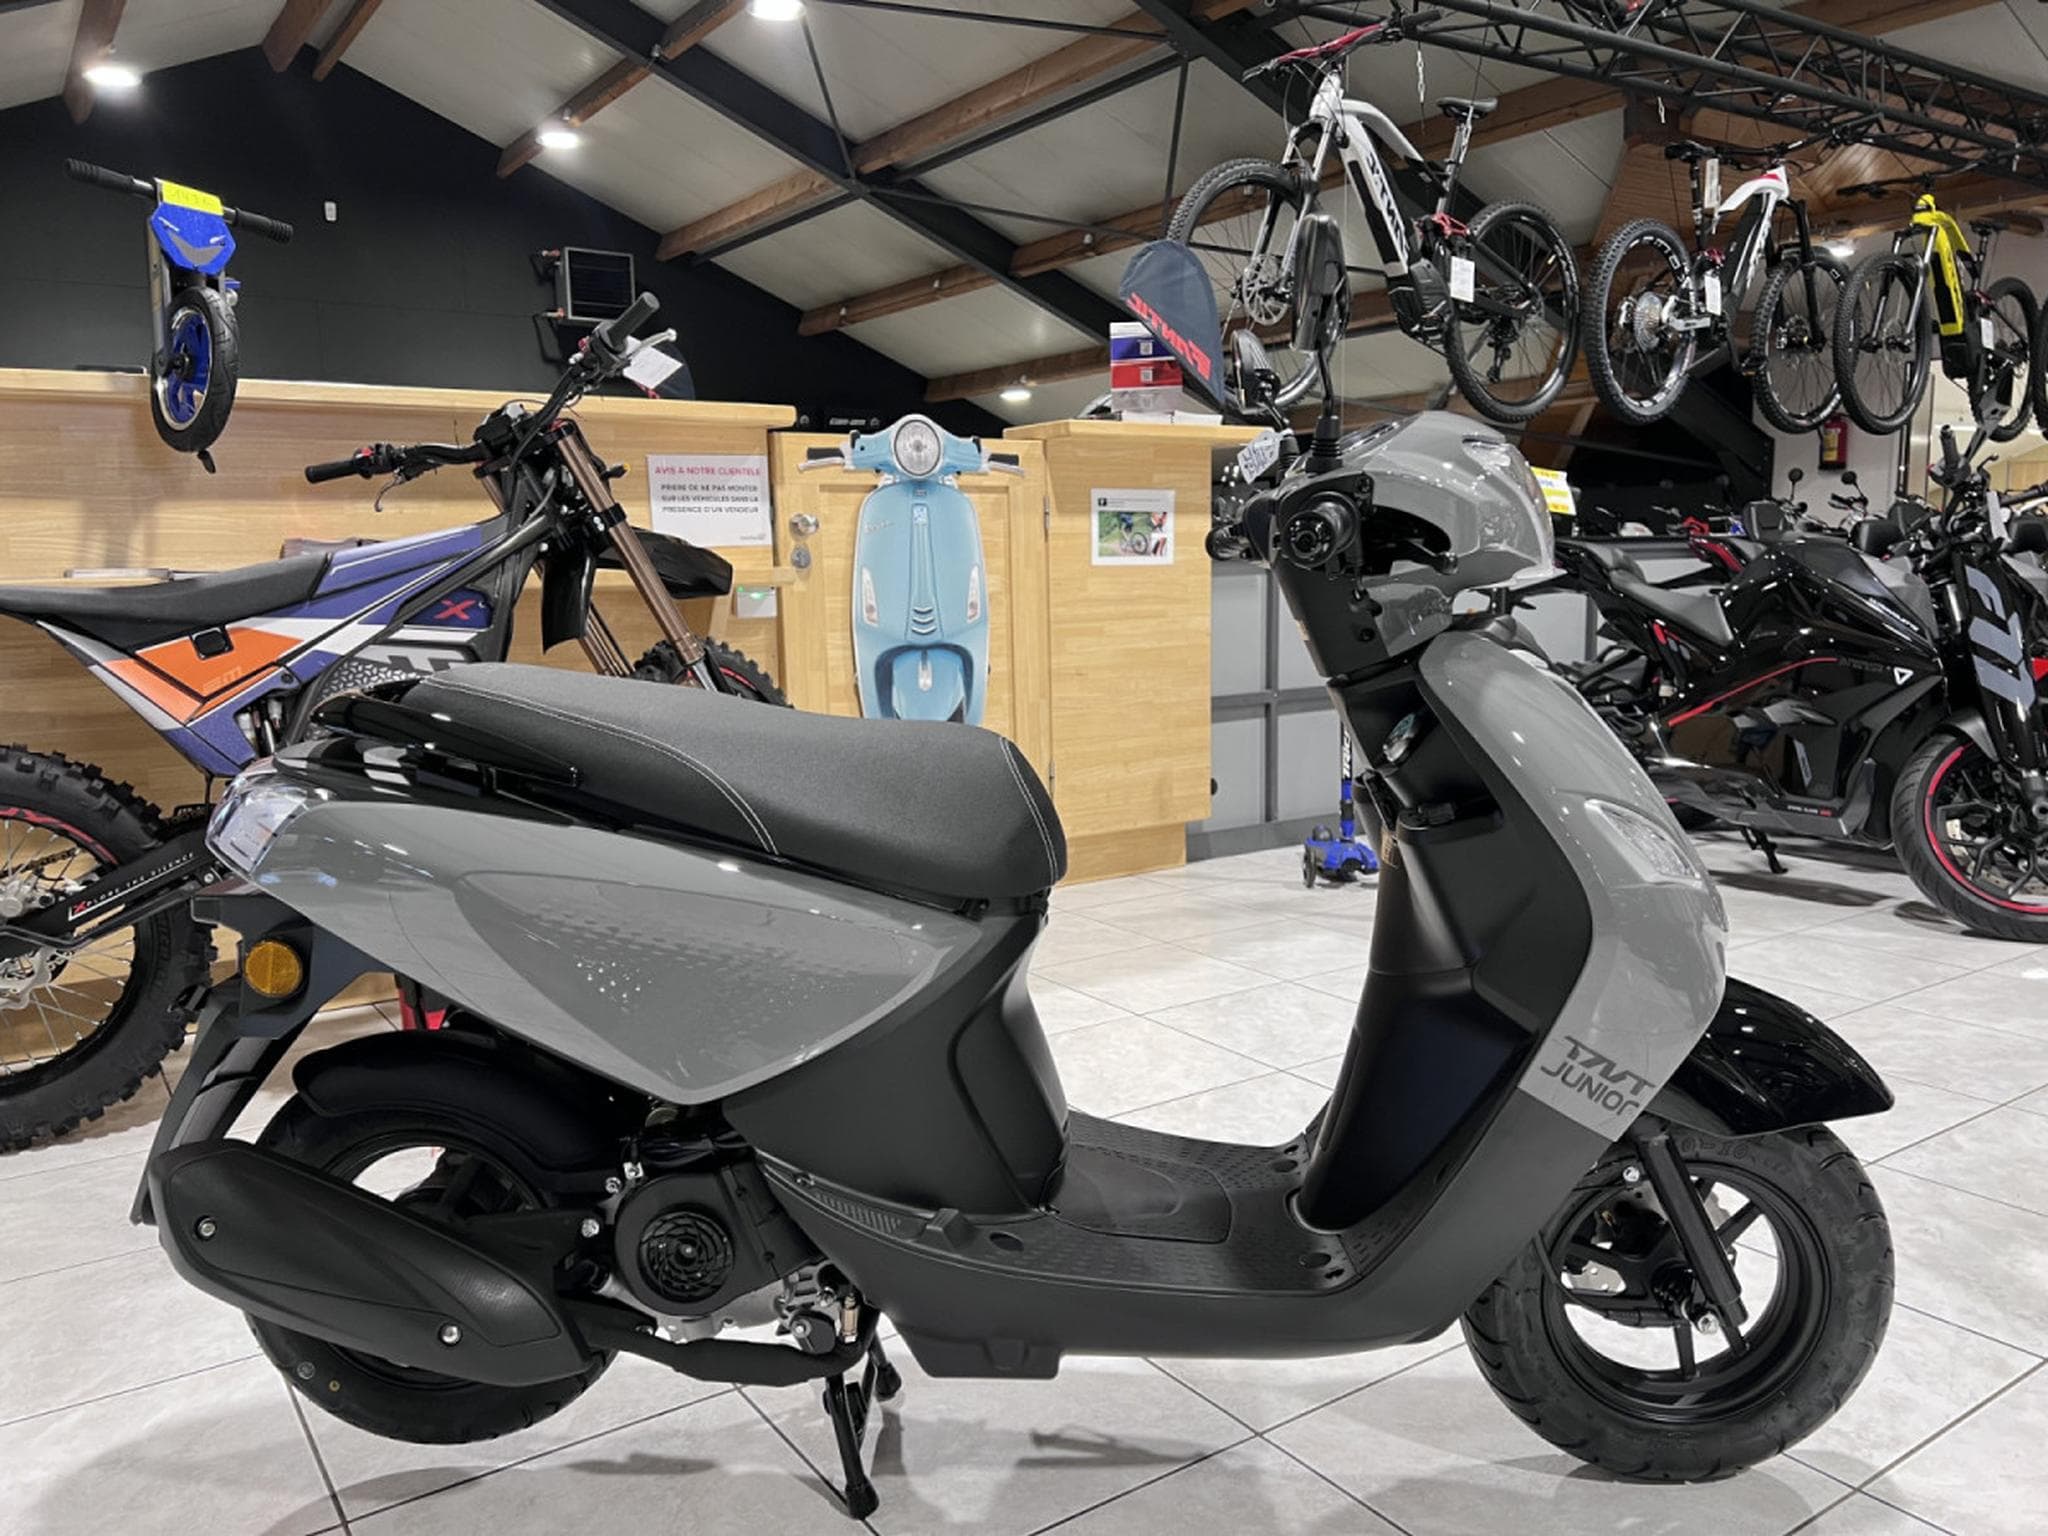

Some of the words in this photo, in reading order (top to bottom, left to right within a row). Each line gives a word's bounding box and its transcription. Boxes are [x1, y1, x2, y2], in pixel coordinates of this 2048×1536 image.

[655, 466, 676, 475] AVIS
[687, 467, 716, 476] NOTRE
[728, 484, 758, 492] MONTER
[126, 875, 145, 888] THE
